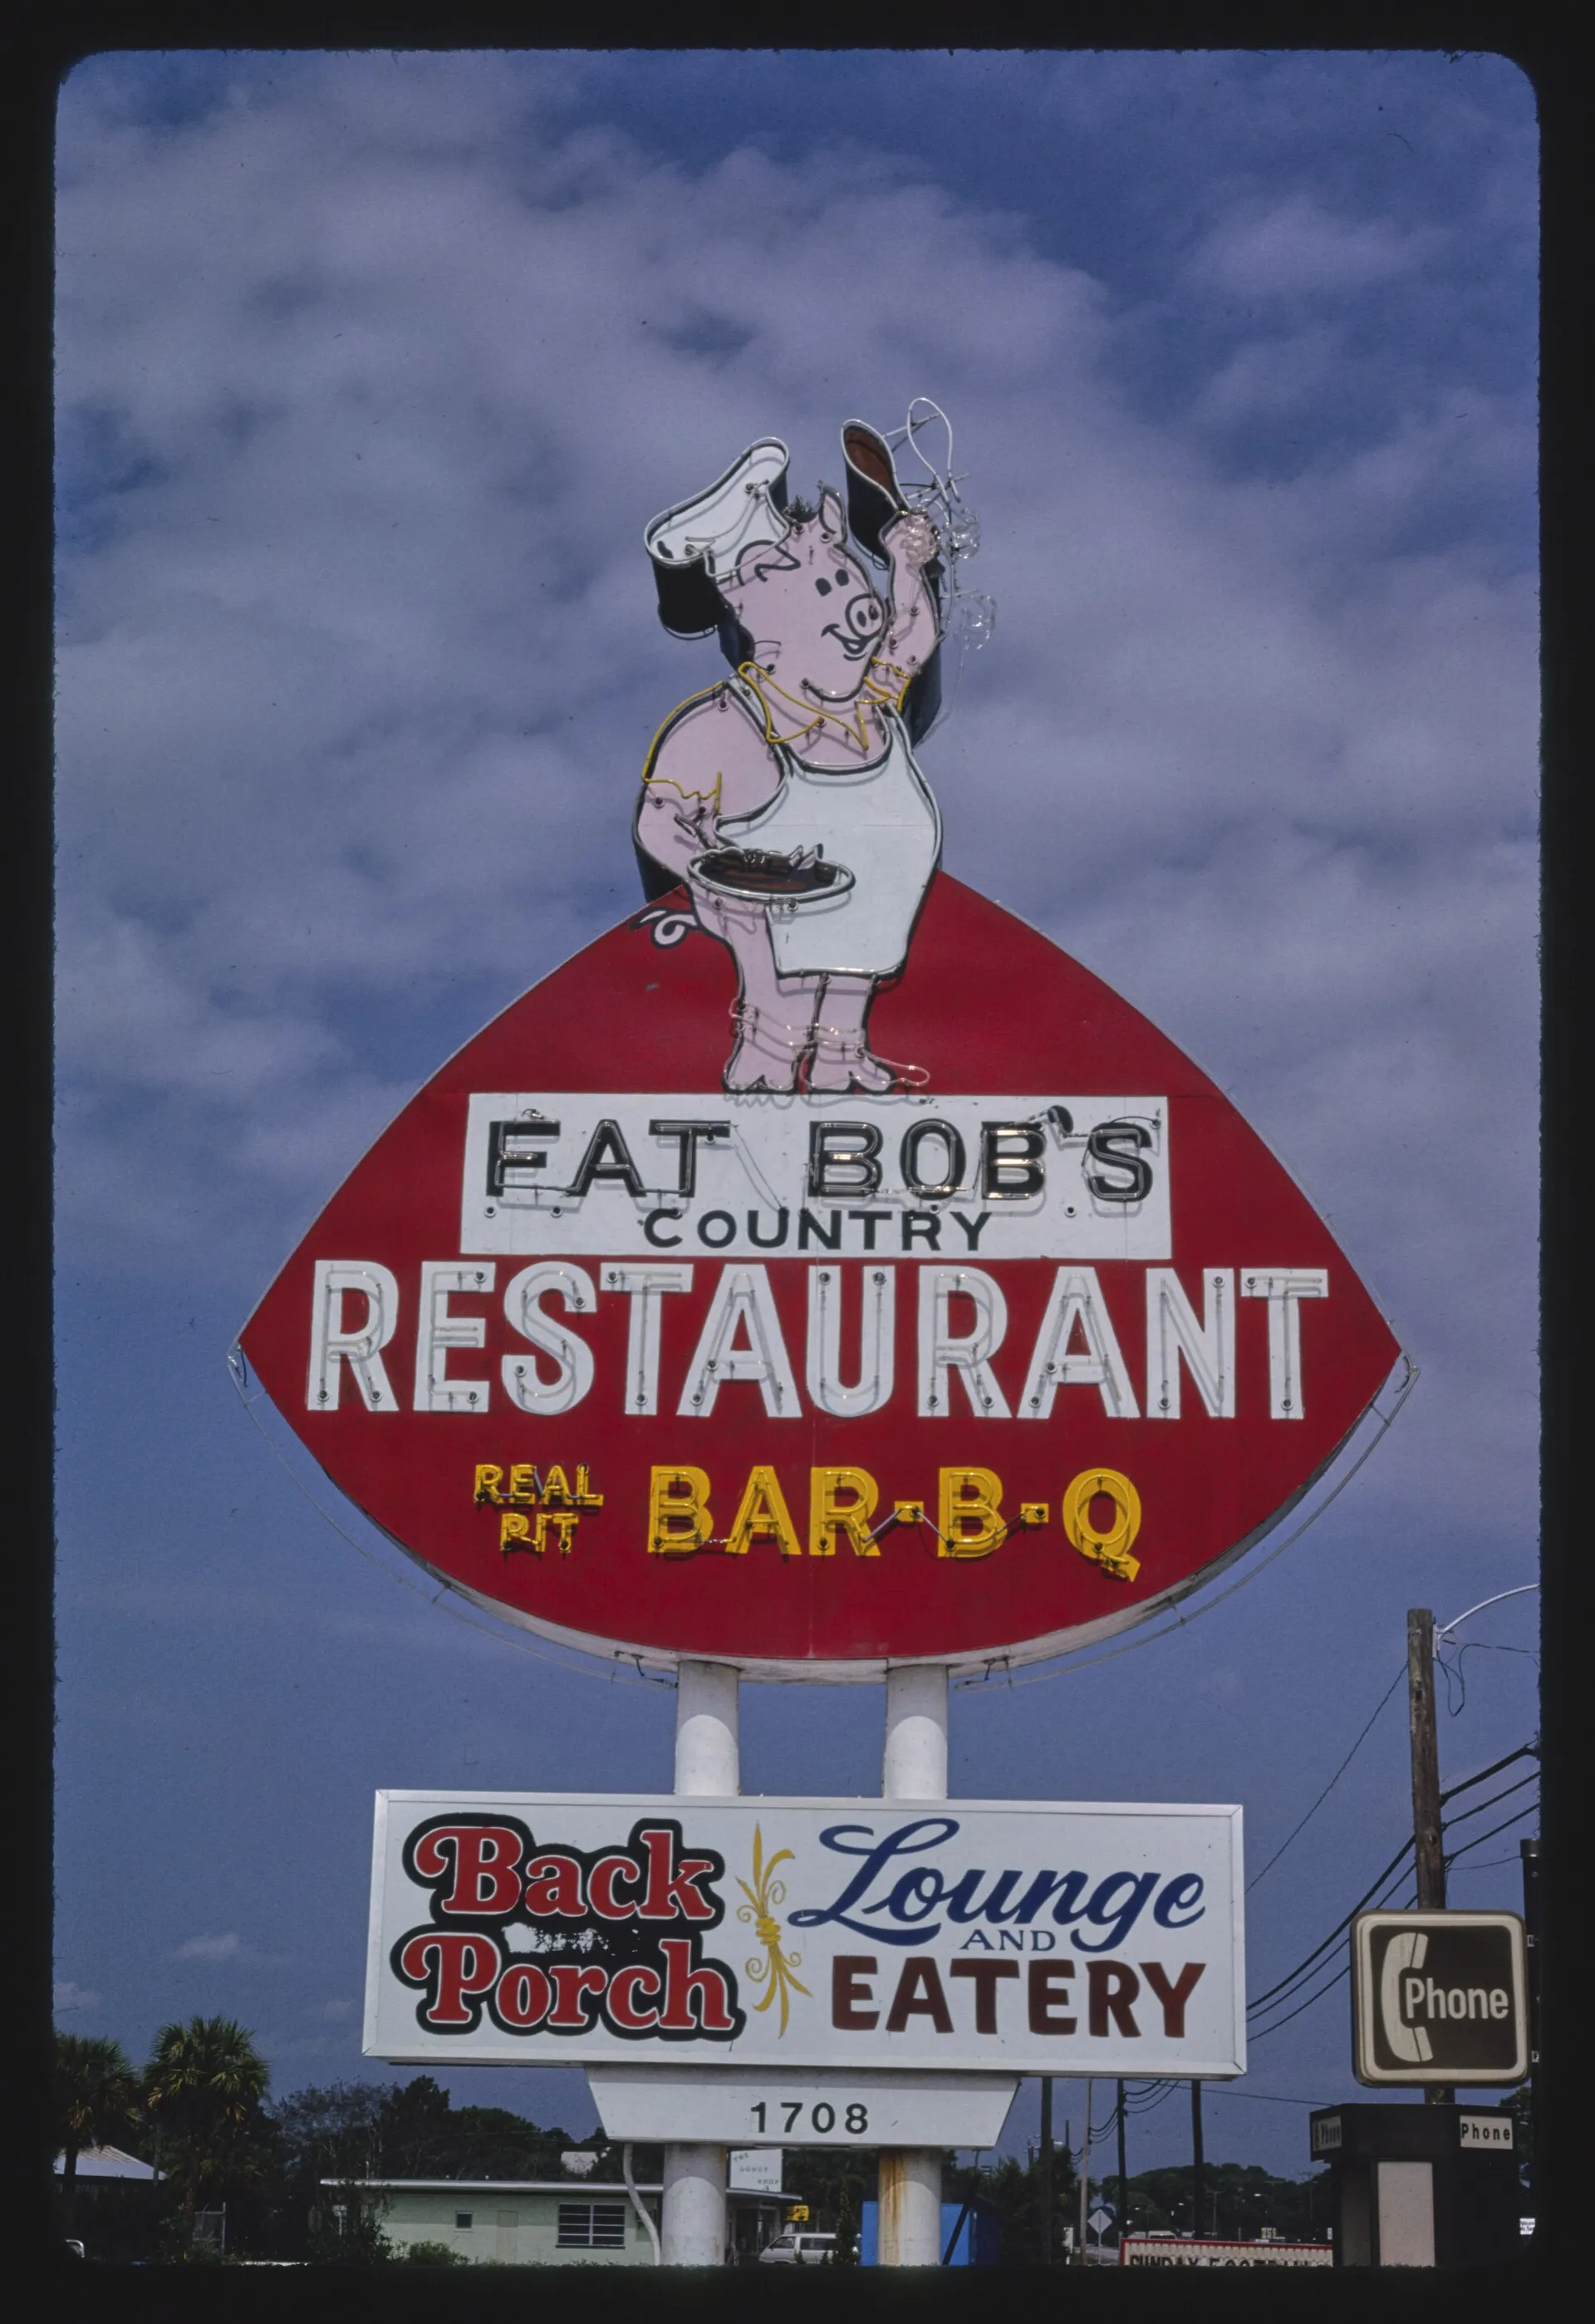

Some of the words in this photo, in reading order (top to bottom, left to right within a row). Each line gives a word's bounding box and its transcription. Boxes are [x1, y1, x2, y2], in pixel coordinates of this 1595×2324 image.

[485, 1119, 730, 1198] FAT
[807, 1106, 1155, 1201] BOB'S
[643, 1209, 992, 1252] COUNTRY
[307, 1260, 1330, 1420] RESTAURANT
[474, 1463, 604, 1506] REAL
[499, 1511, 580, 1553] PIT
[647, 1465, 1142, 1583] BAR-B-Q
[410, 1821, 719, 1922] Back
[787, 1817, 1206, 1953] Lounge
[959, 1928, 1057, 1952] AND
[398, 1929, 738, 2032] Porch
[832, 1954, 1207, 2039] EATERY
[1405, 1977, 1509, 2020] Phone
[750, 2100, 870, 2135] 1708
[1460, 2122, 1511, 2141] Phone
